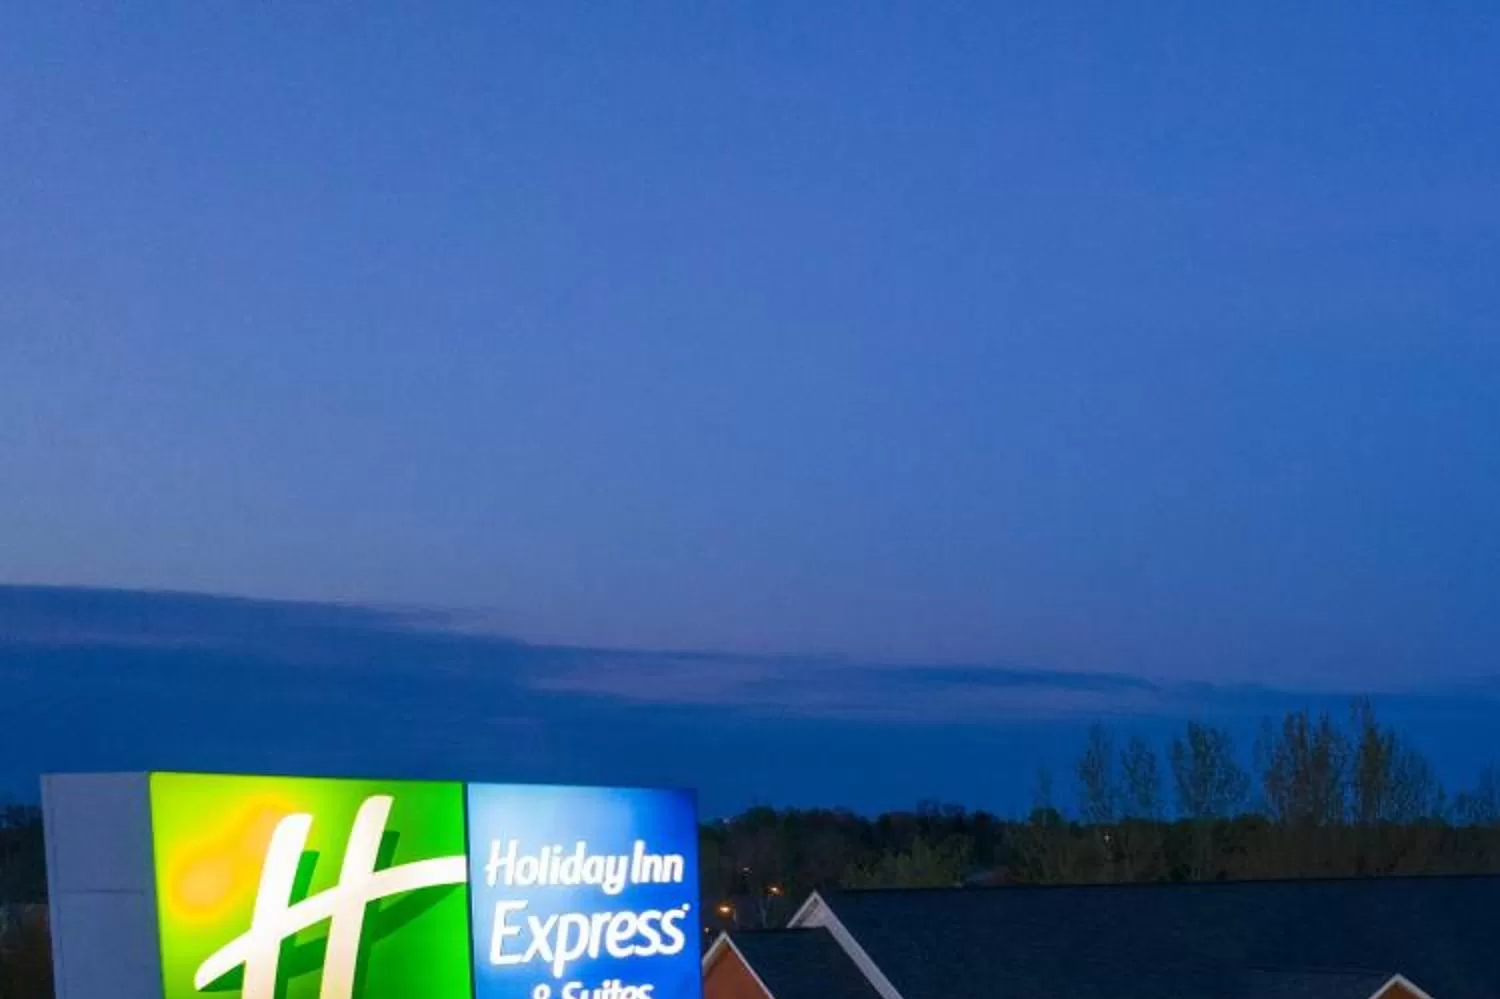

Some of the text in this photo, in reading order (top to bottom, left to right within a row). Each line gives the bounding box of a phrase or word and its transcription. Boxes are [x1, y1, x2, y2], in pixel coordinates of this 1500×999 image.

[485, 839, 685, 895] Holiday Inn
[490, 899, 687, 979] Express
